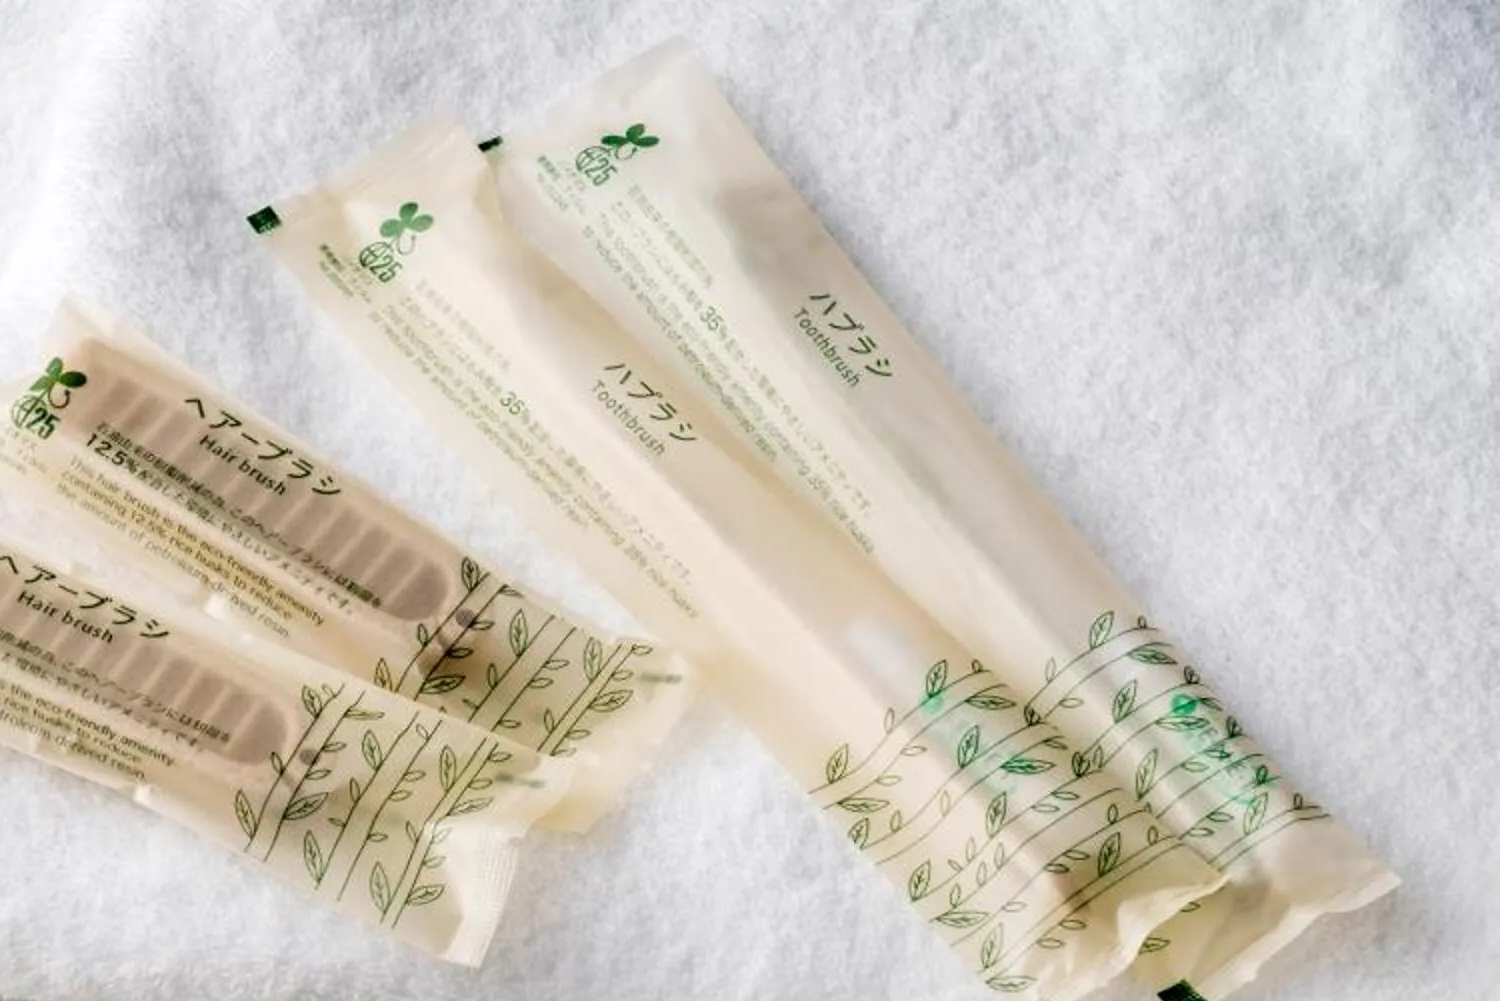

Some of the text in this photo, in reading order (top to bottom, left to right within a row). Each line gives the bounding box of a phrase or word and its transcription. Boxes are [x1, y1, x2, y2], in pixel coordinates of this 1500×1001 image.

[586, 158, 614, 185] 25
[372, 254, 400, 282] 25
[793, 308, 861, 386] Toothbrush
[810, 285, 896, 382] ハブラシ
[26, 407, 59, 439] 25
[590, 380, 666, 456] Toothbrush
[606, 356, 699, 448] ハブラシ
[180, 394, 343, 500] ヘアーブラシ
[198, 434, 287, 494] Hair brush
[17, 589, 114, 644] Hair brush
